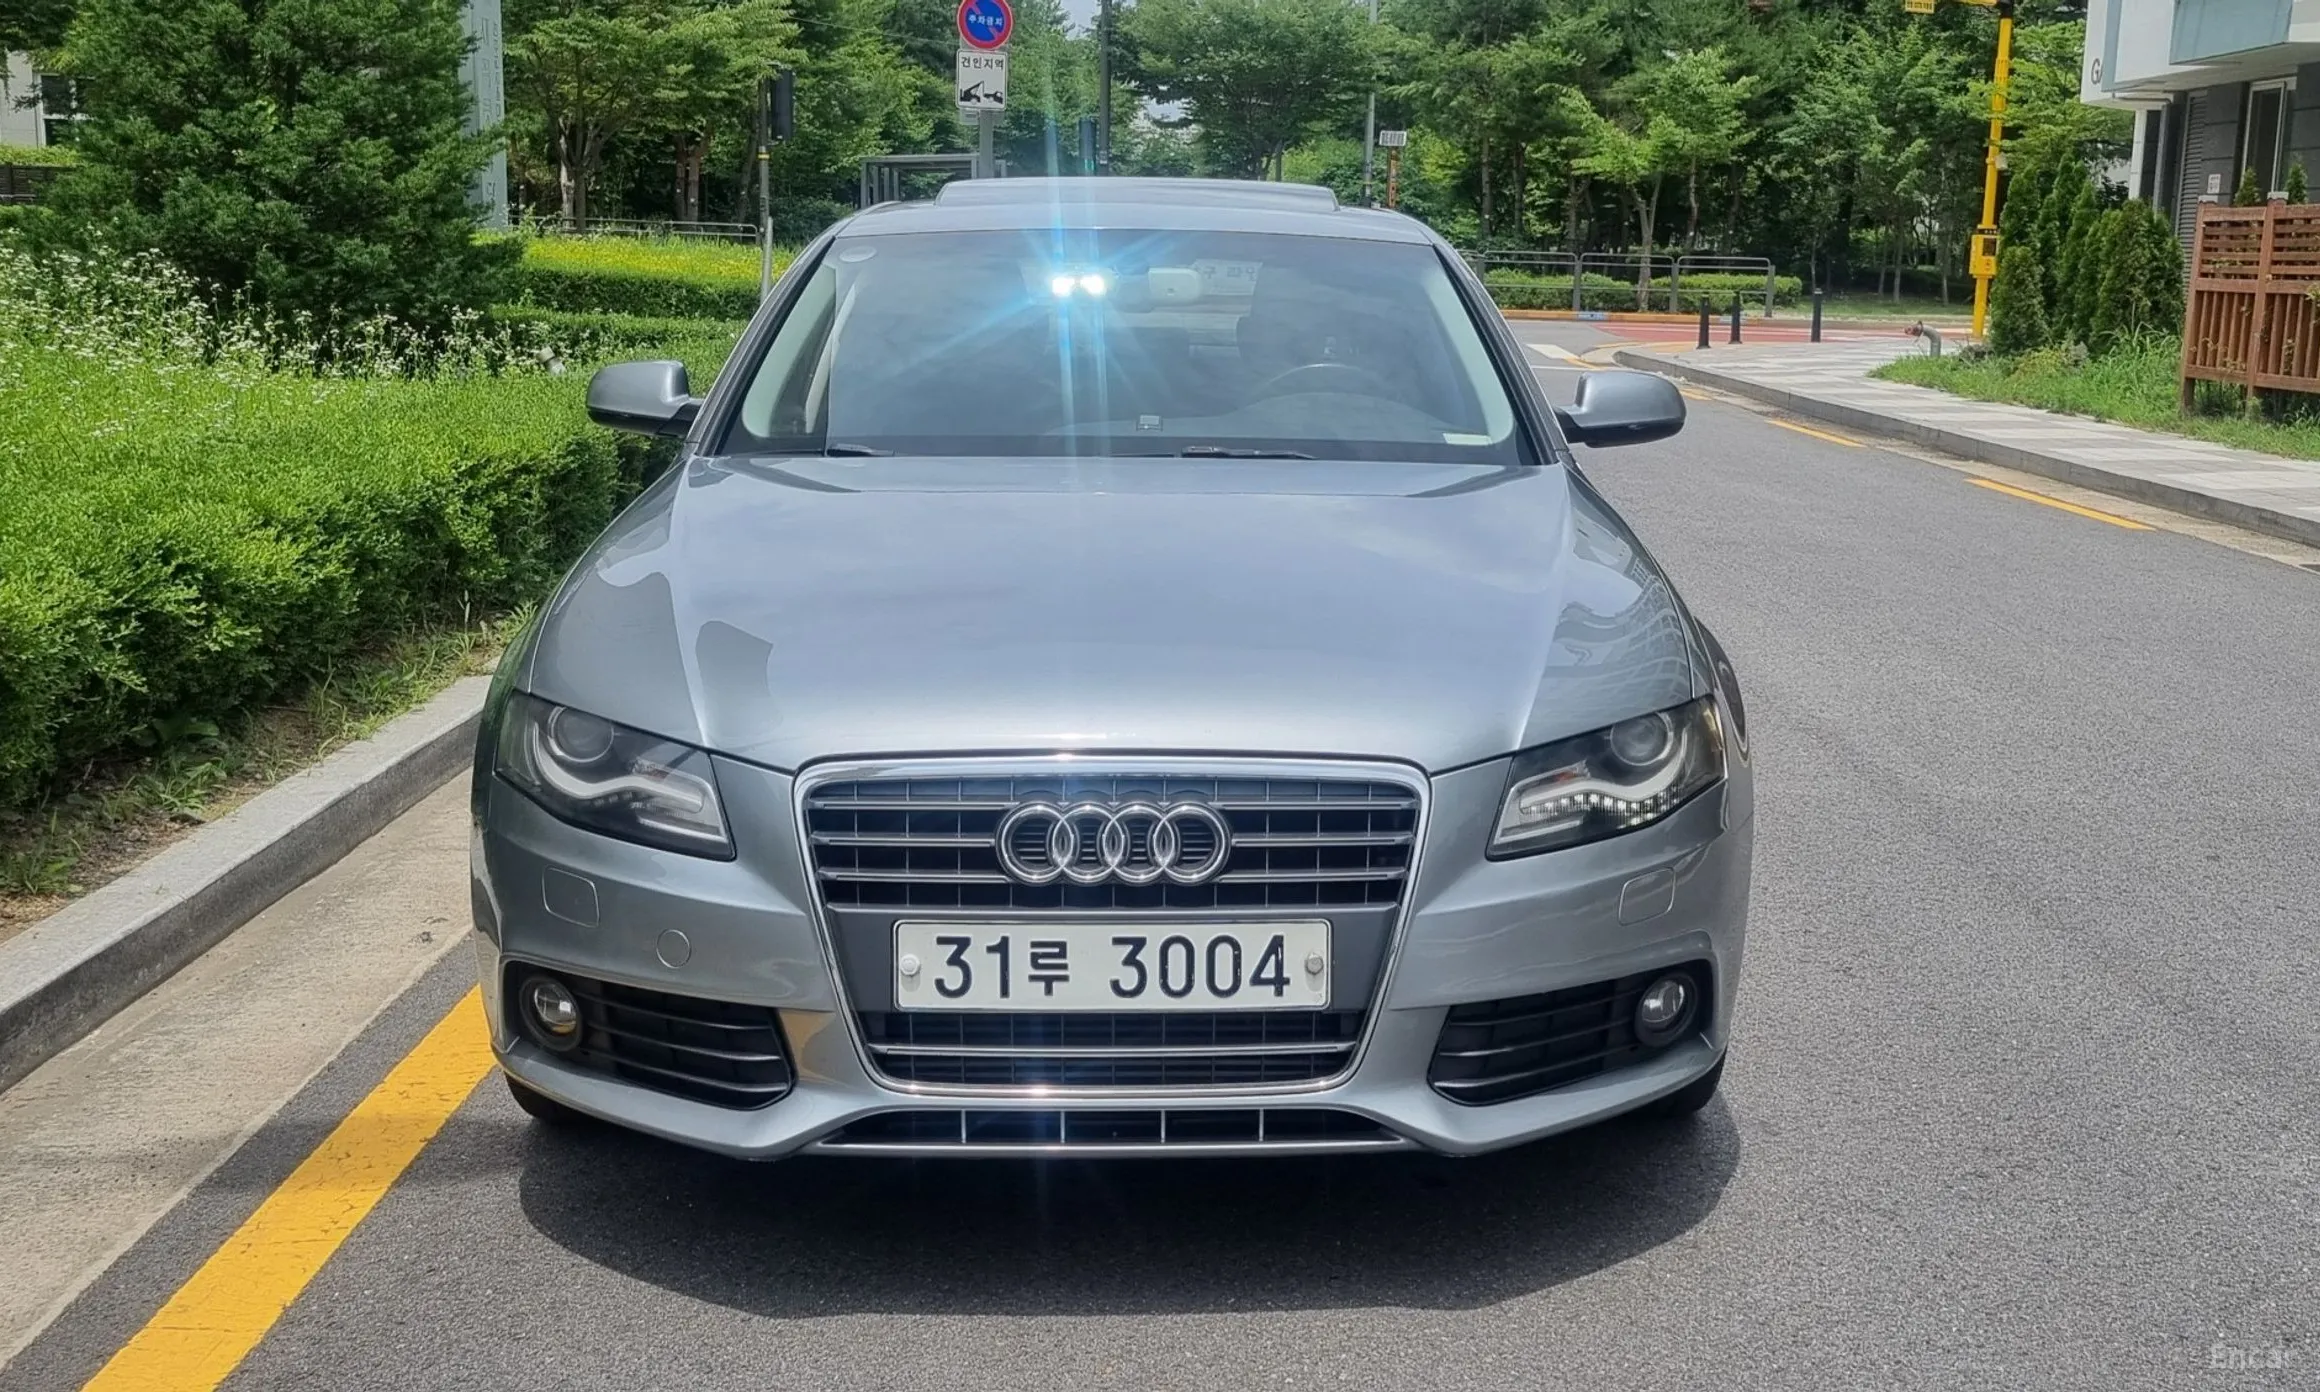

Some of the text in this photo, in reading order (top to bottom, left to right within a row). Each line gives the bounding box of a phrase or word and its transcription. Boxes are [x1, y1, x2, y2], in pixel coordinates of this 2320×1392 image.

[968, 14, 1003, 26] 주차금지
[934, 935, 1291, 998] 31루 3004
